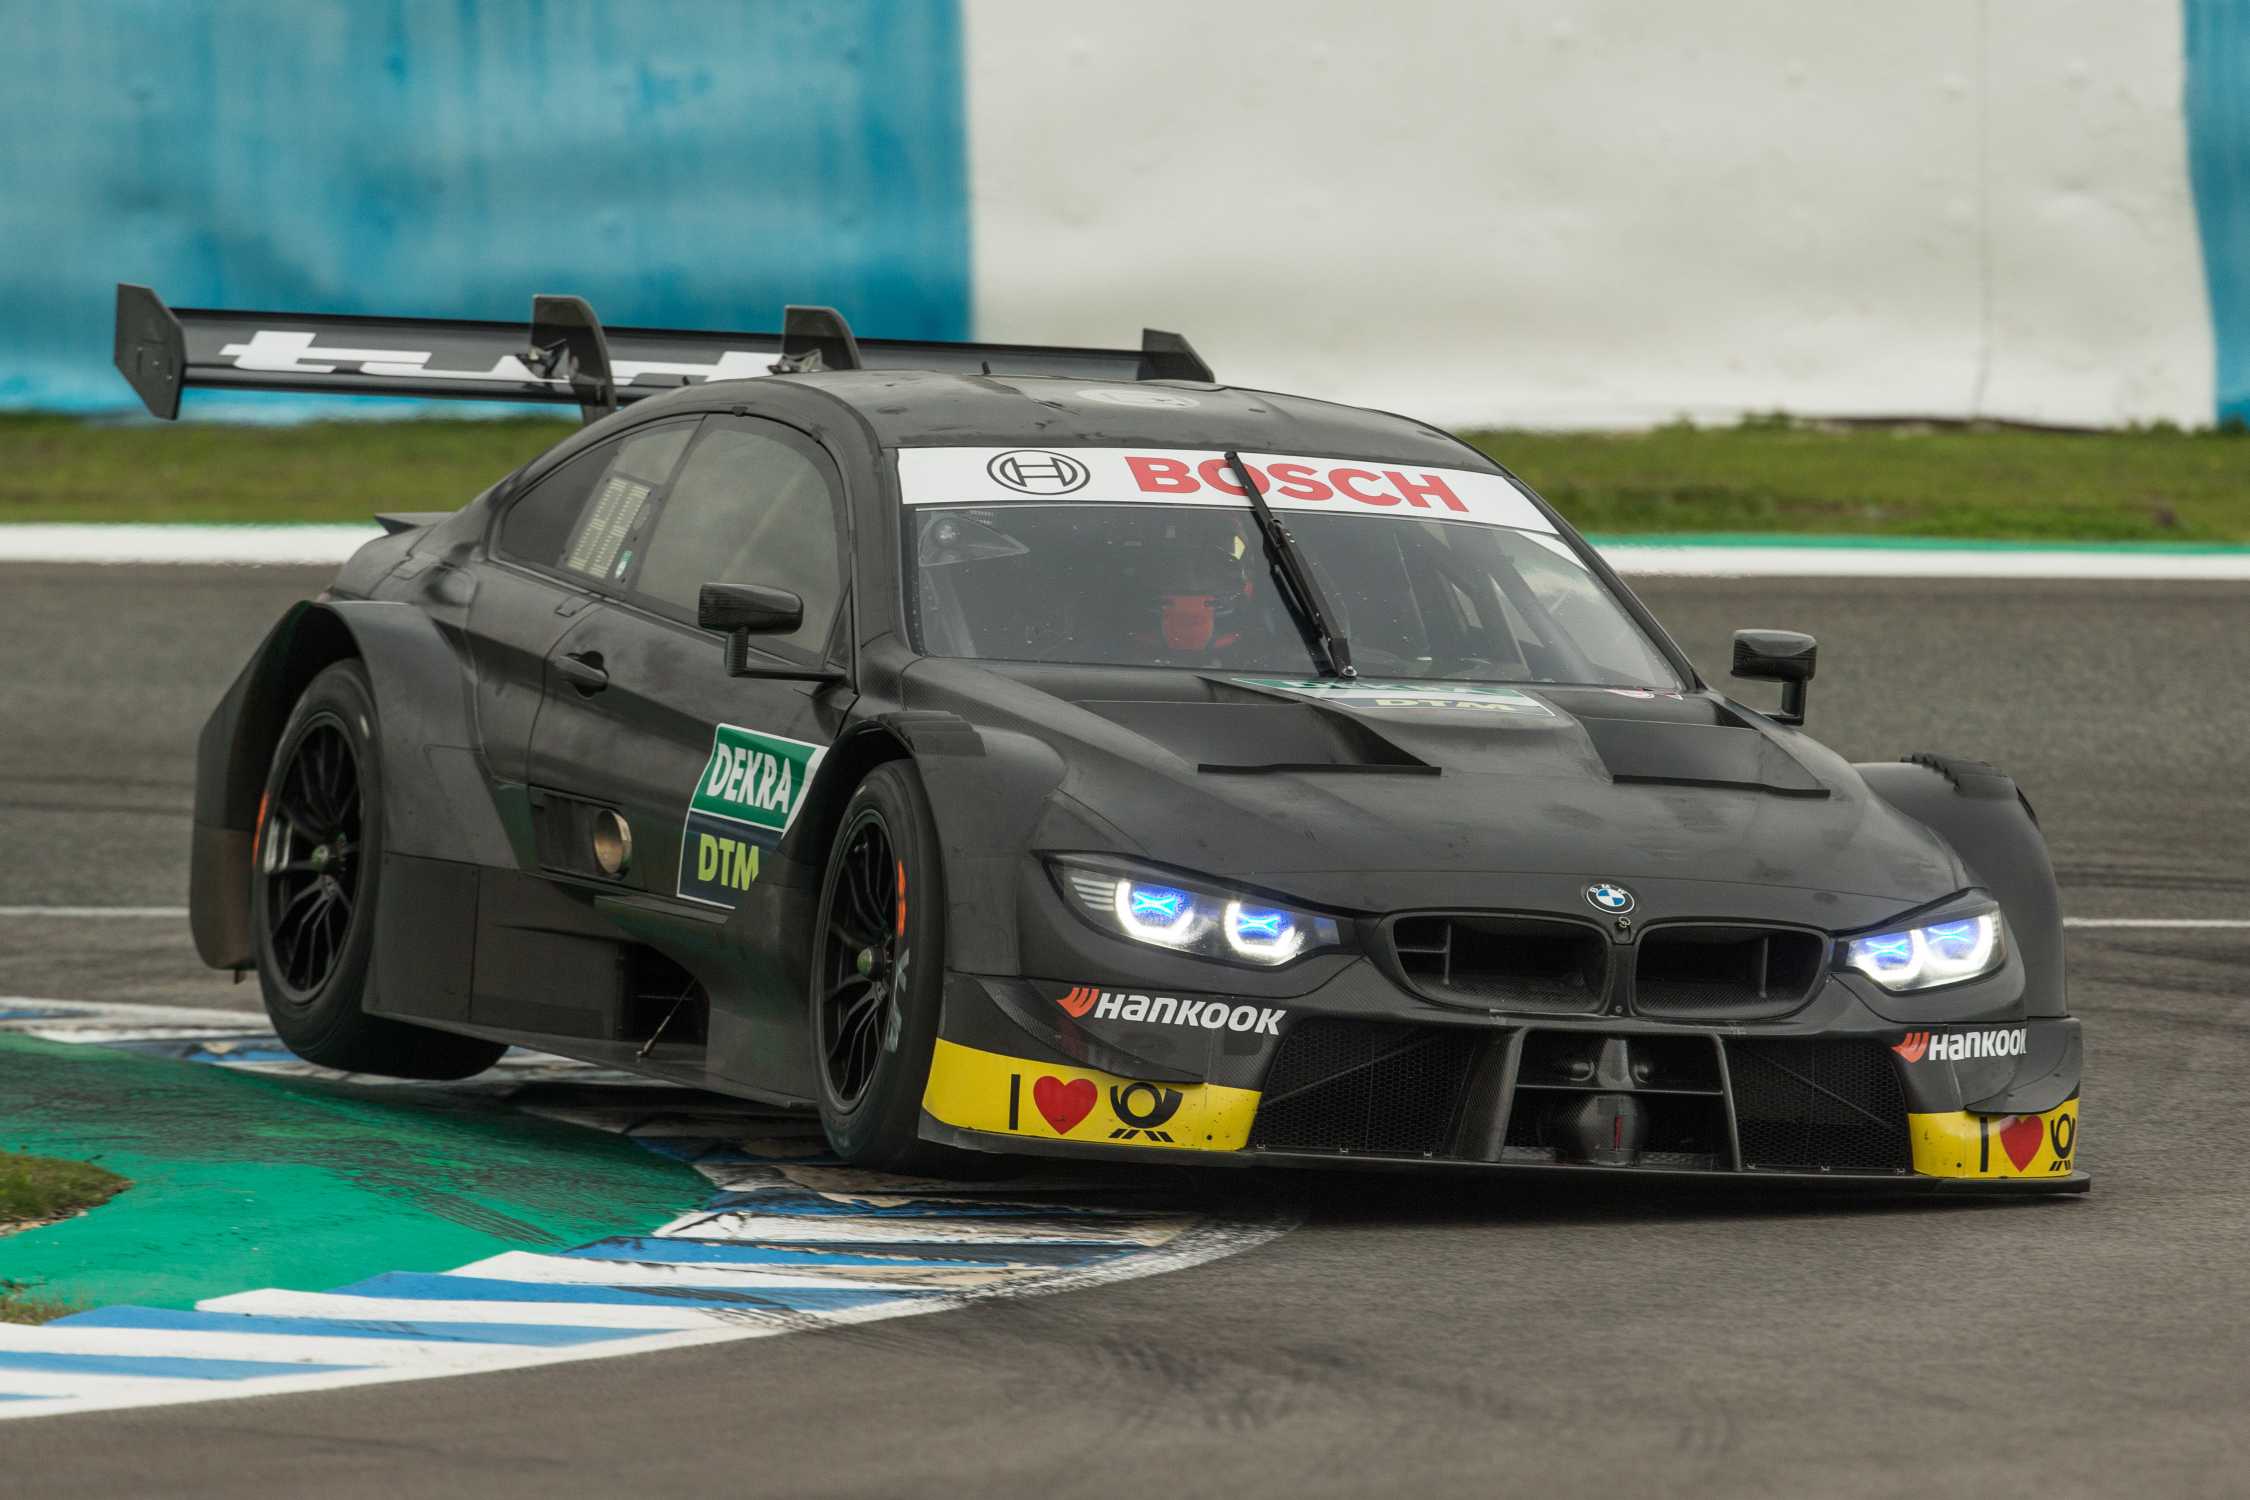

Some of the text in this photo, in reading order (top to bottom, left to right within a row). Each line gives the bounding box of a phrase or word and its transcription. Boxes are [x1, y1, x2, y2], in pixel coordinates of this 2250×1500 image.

[1124, 456, 1470, 513] BOSCH
[1375, 699, 1516, 711] DTM
[706, 743, 792, 814] DEKRA
[698, 833, 760, 891] DTM
[1009, 1073, 1021, 1131] I
[1980, 1115, 1990, 1173] I
